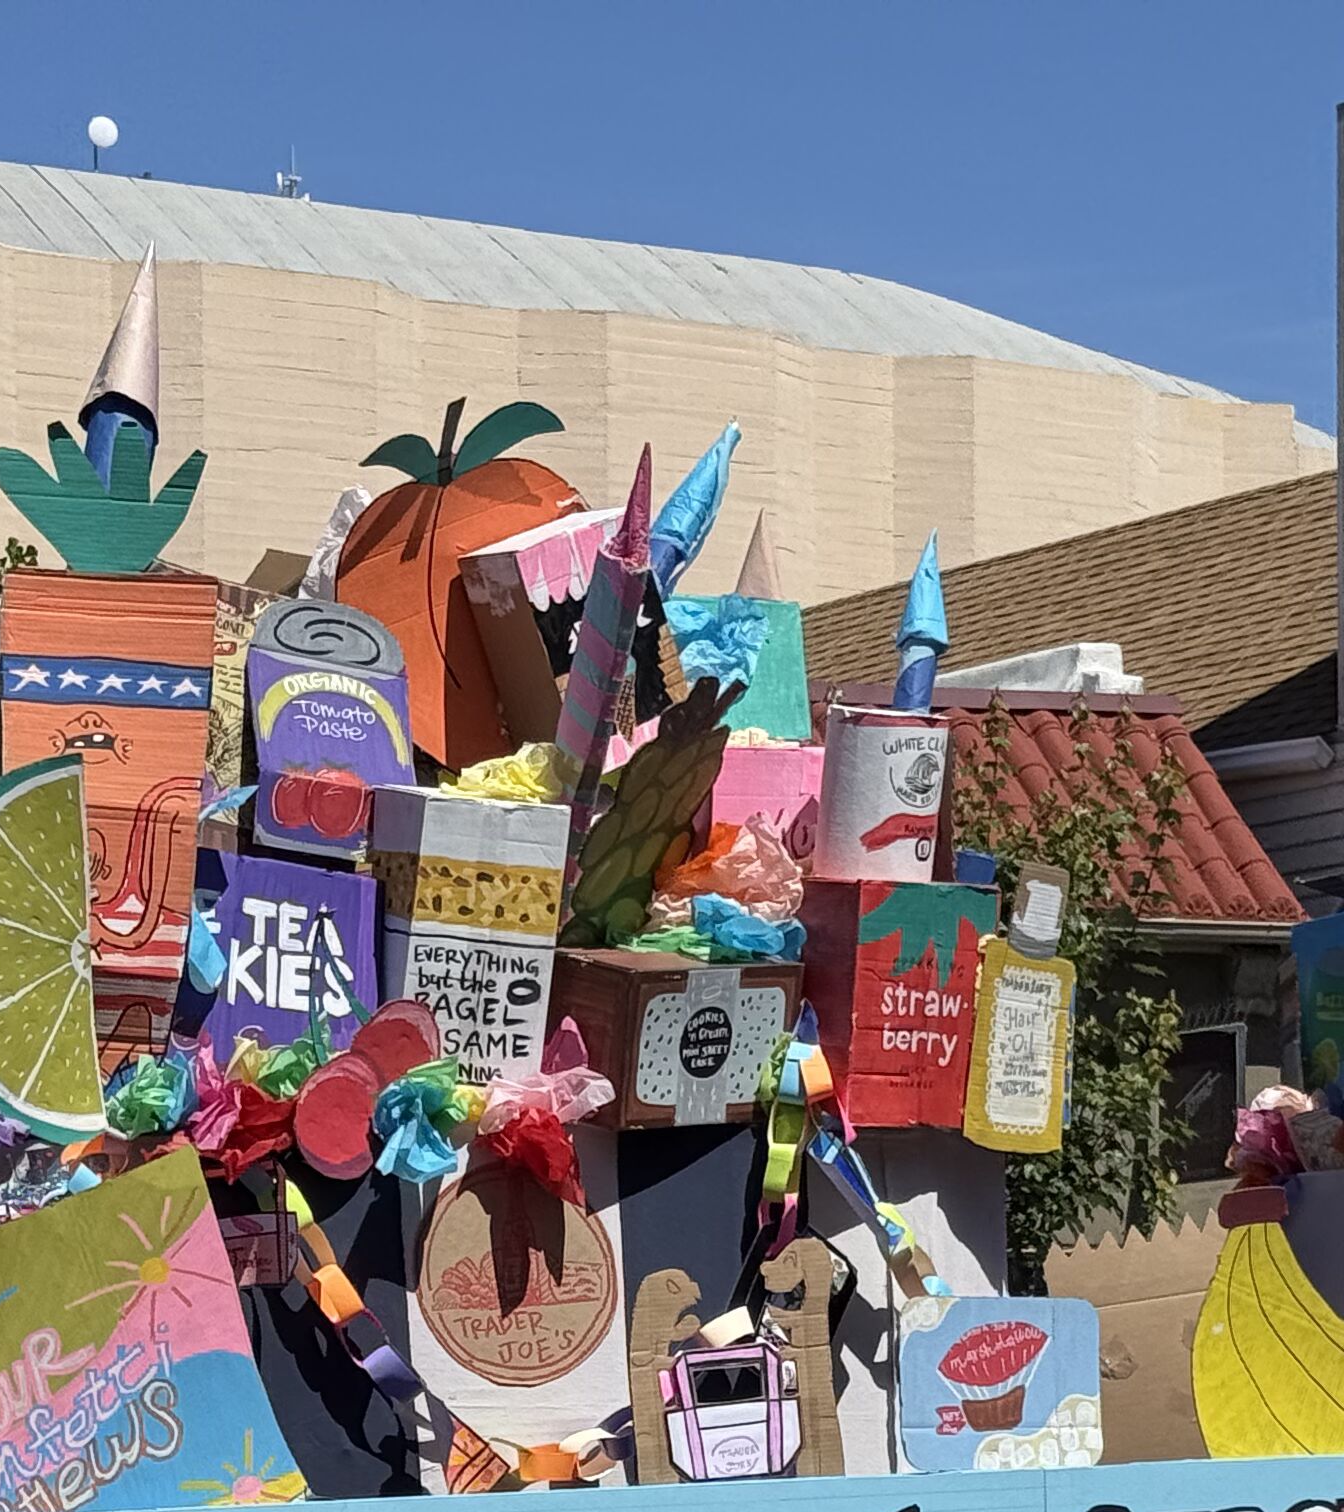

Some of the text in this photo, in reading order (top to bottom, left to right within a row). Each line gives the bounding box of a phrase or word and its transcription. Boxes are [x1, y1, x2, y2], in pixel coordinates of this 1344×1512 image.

[284, 673, 378, 705] ORGANIC
[292, 699, 377, 726] Tomato
[293, 714, 368, 741] Paste
[882, 736, 925, 756] WHITE
[242, 897, 345, 957] TEA
[414, 944, 540, 978] EVERYTHING
[417, 966, 498, 995] but the
[1003, 1006, 1040, 1032] Hair
[882, 1021, 959, 1068] berry
[453, 1310, 550, 1340] TRADER
[498, 1329, 576, 1364] JOE'S
